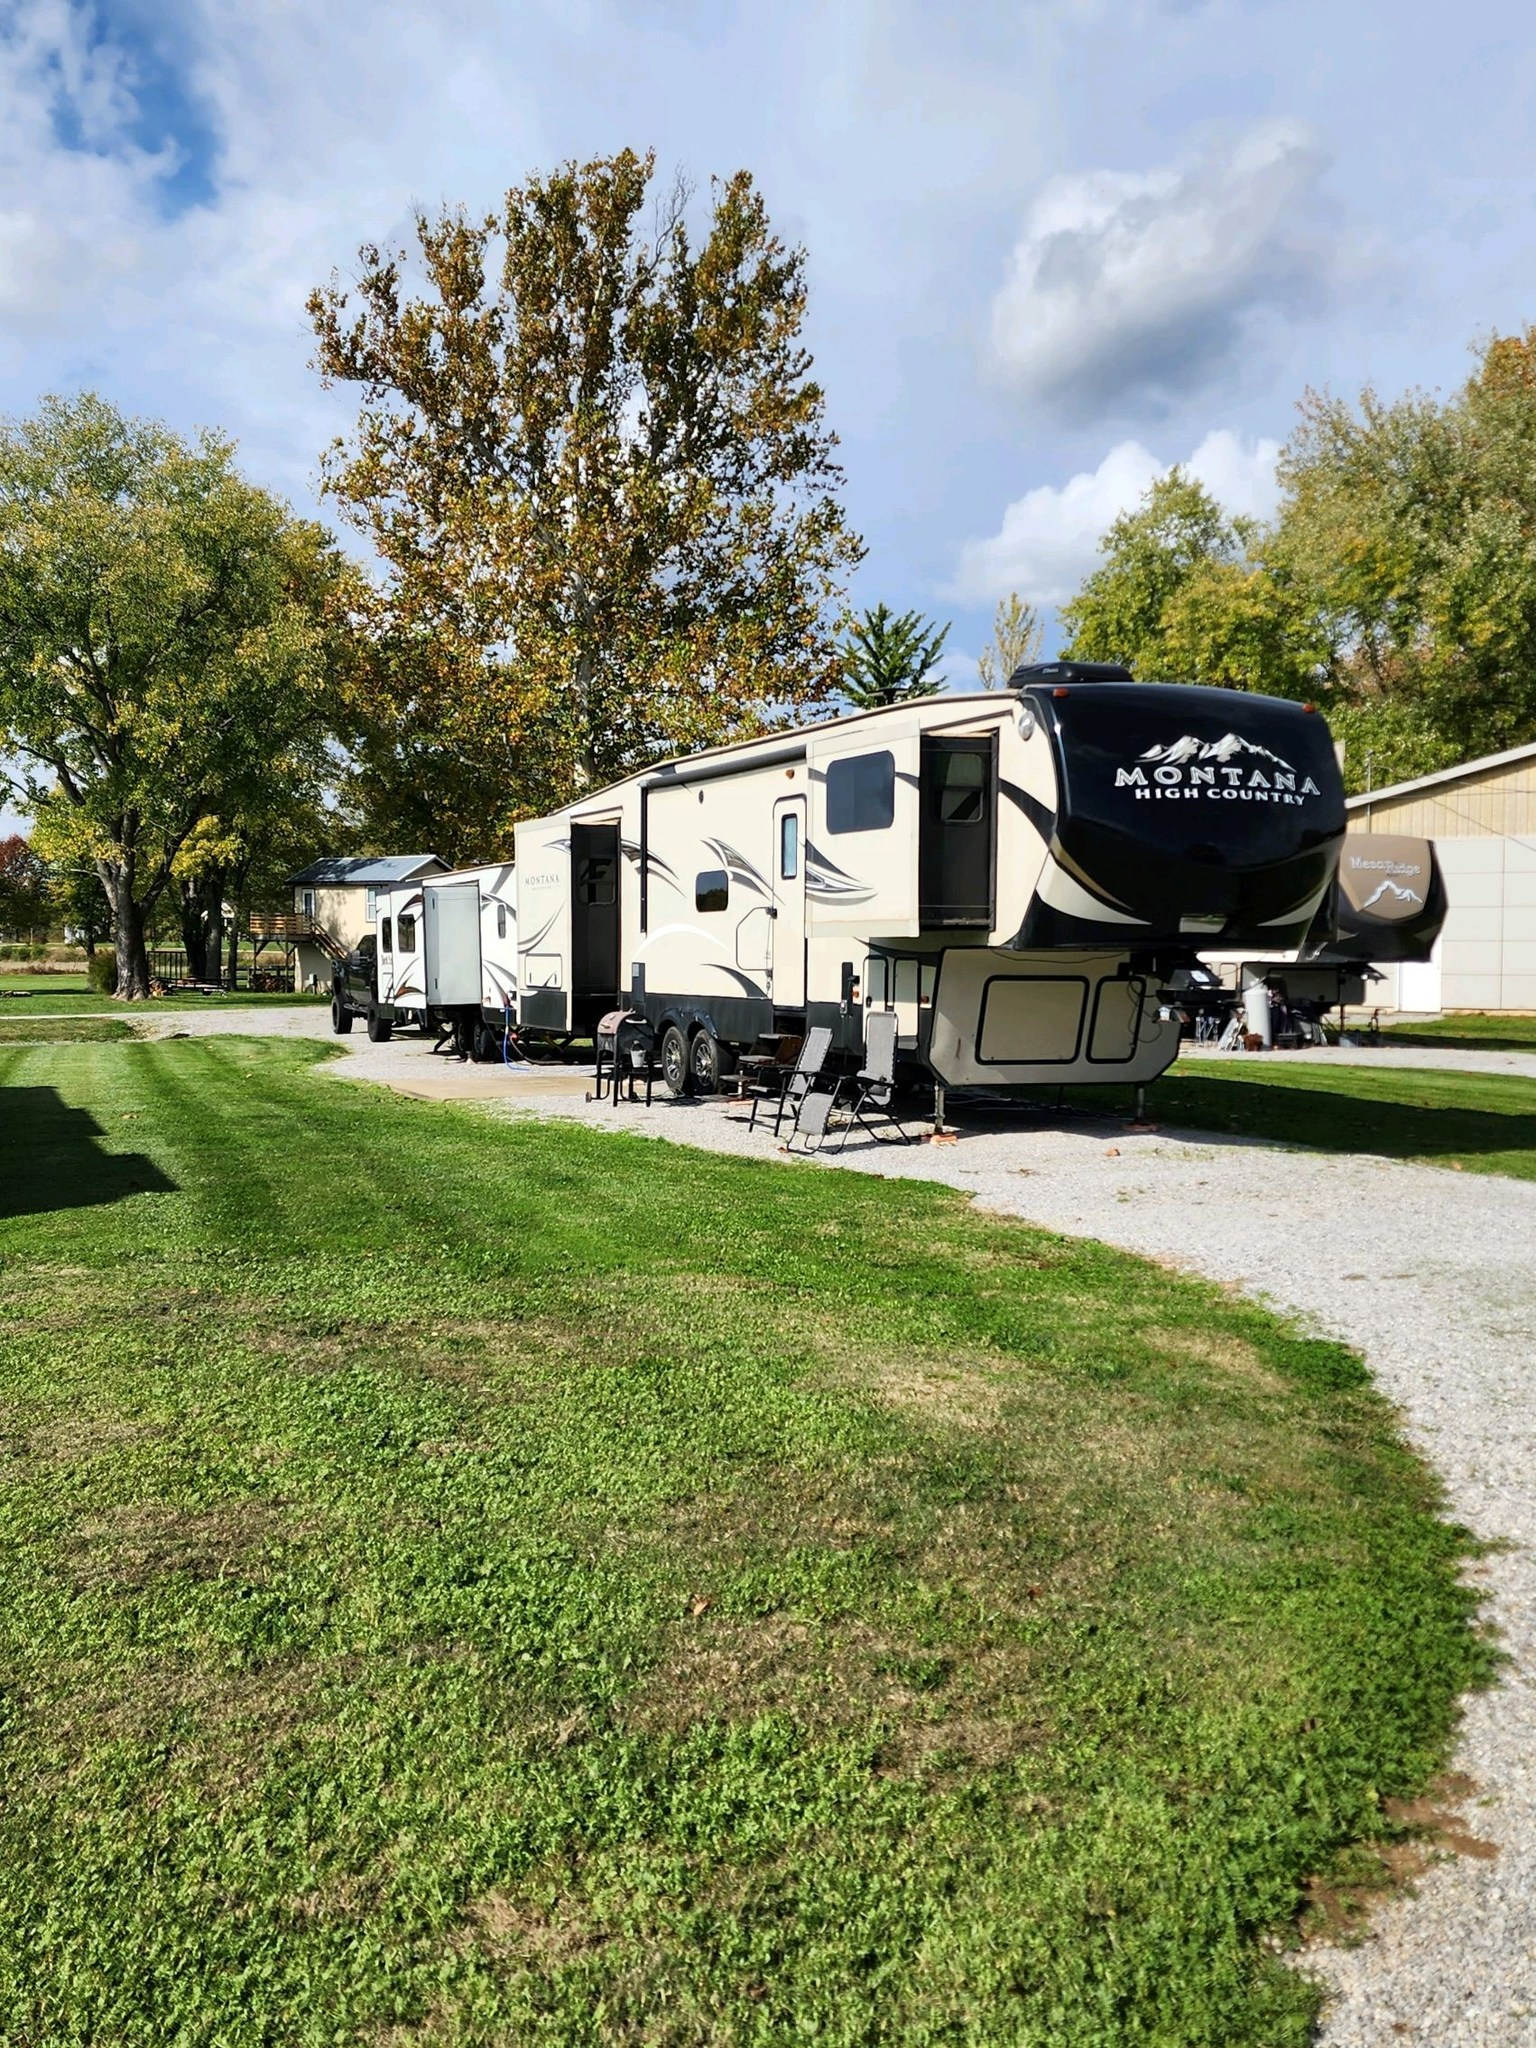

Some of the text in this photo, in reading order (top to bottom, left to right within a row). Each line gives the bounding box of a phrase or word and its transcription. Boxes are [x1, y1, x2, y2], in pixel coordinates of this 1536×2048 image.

[1114, 766, 1320, 795] MONTANA
[1135, 788, 1304, 805] HIGH COUNTRY
[525, 873, 560, 886] MONTANA
